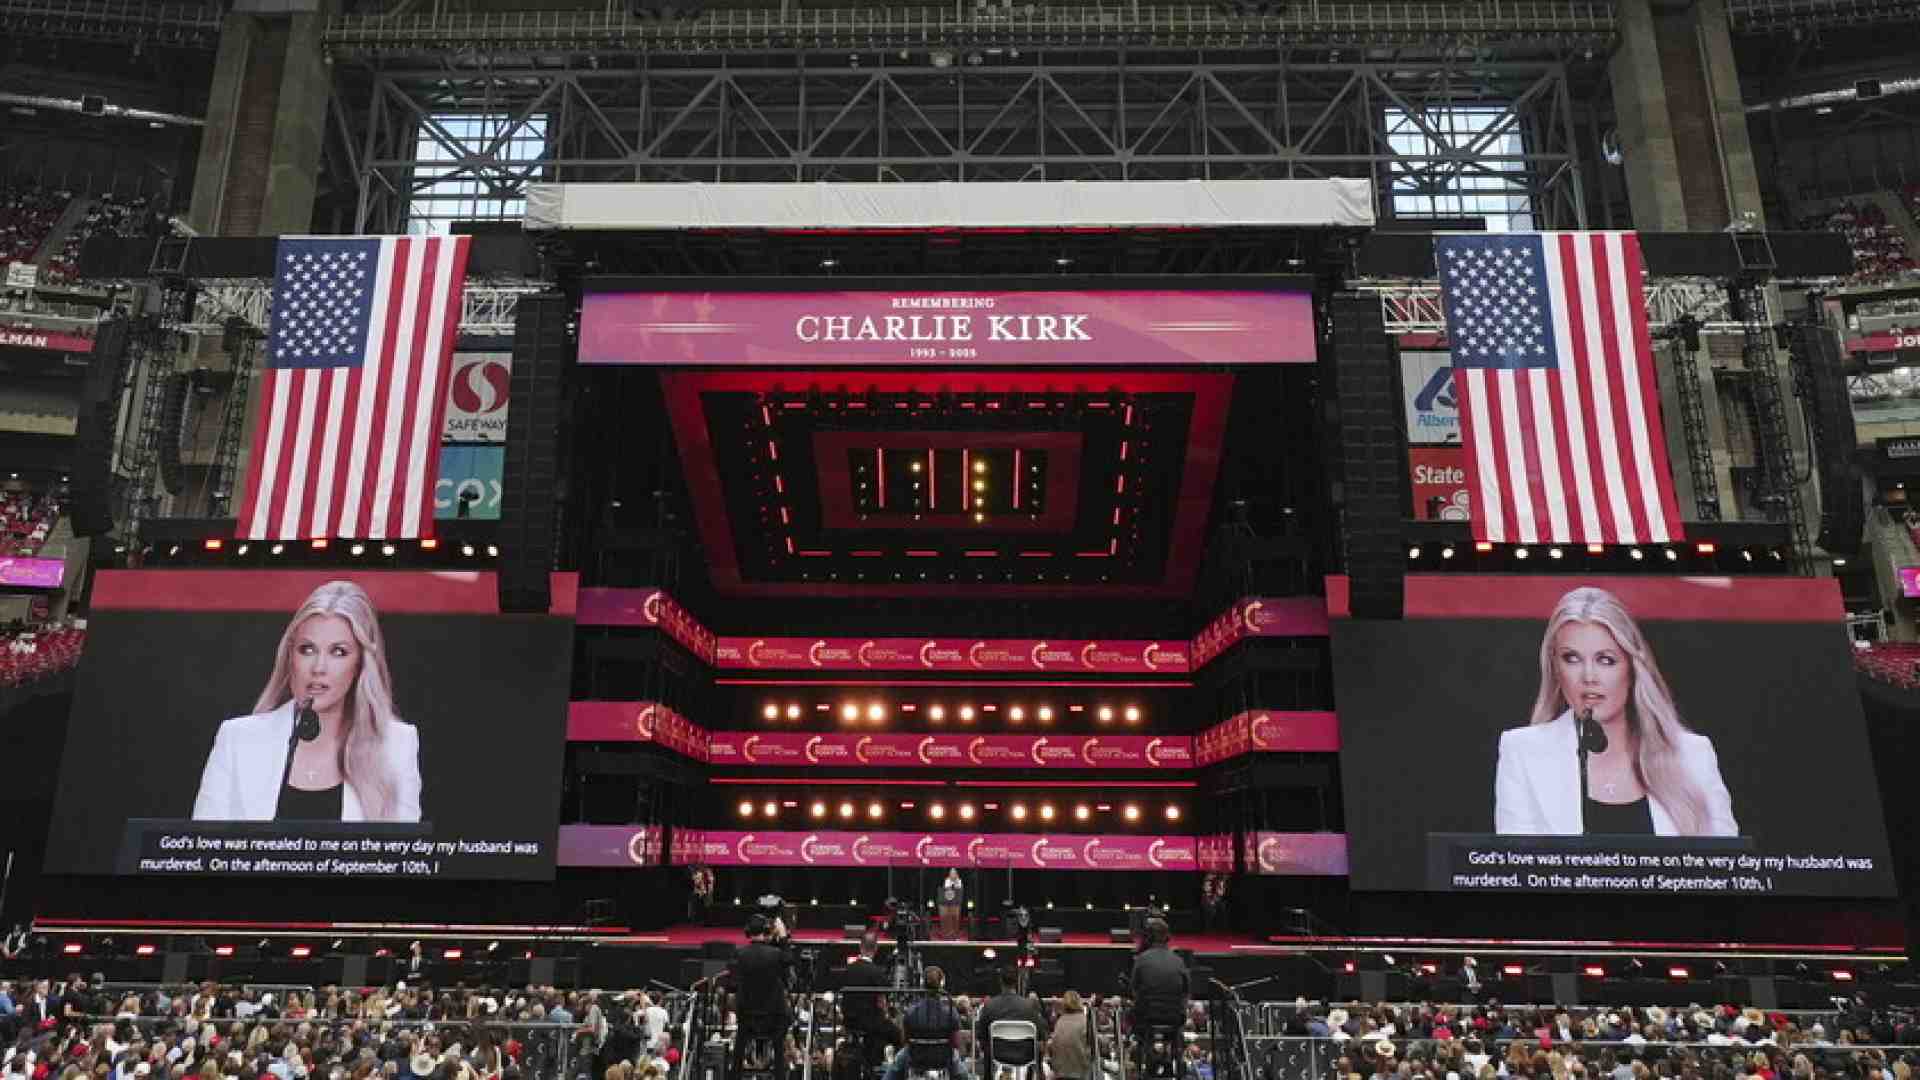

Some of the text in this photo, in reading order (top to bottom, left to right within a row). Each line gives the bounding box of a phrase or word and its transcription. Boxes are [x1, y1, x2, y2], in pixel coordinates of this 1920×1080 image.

[892, 297, 995, 309] REMEMBERING
[796, 314, 1093, 342] CHARLIE KIRK
[448, 419, 505, 431] SAFEWAY
[1414, 465, 1464, 484] State
[160, 836, 538, 856] God's love was revealed to me on the very day my husband was
[141, 857, 203, 870] murdered.
[209, 858, 228, 871] On
[231, 858, 251, 871] the
[253, 858, 314, 872] afternoon
[316, 859, 330, 872] of
[331, 859, 398, 875] September
[403, 861, 431, 874] 10th,
[1469, 852, 1872, 871] God's love was revealed to me on the very day my husband was
[1454, 873, 1521, 886] murdered.
[1528, 875, 1547, 886] On
[1549, 874, 1572, 887] the
[1574, 874, 1638, 888] afternoon
[1640, 875, 1654, 888] of
[1657, 875, 1728, 892] September
[1731, 877, 1764, 891] 10th,
